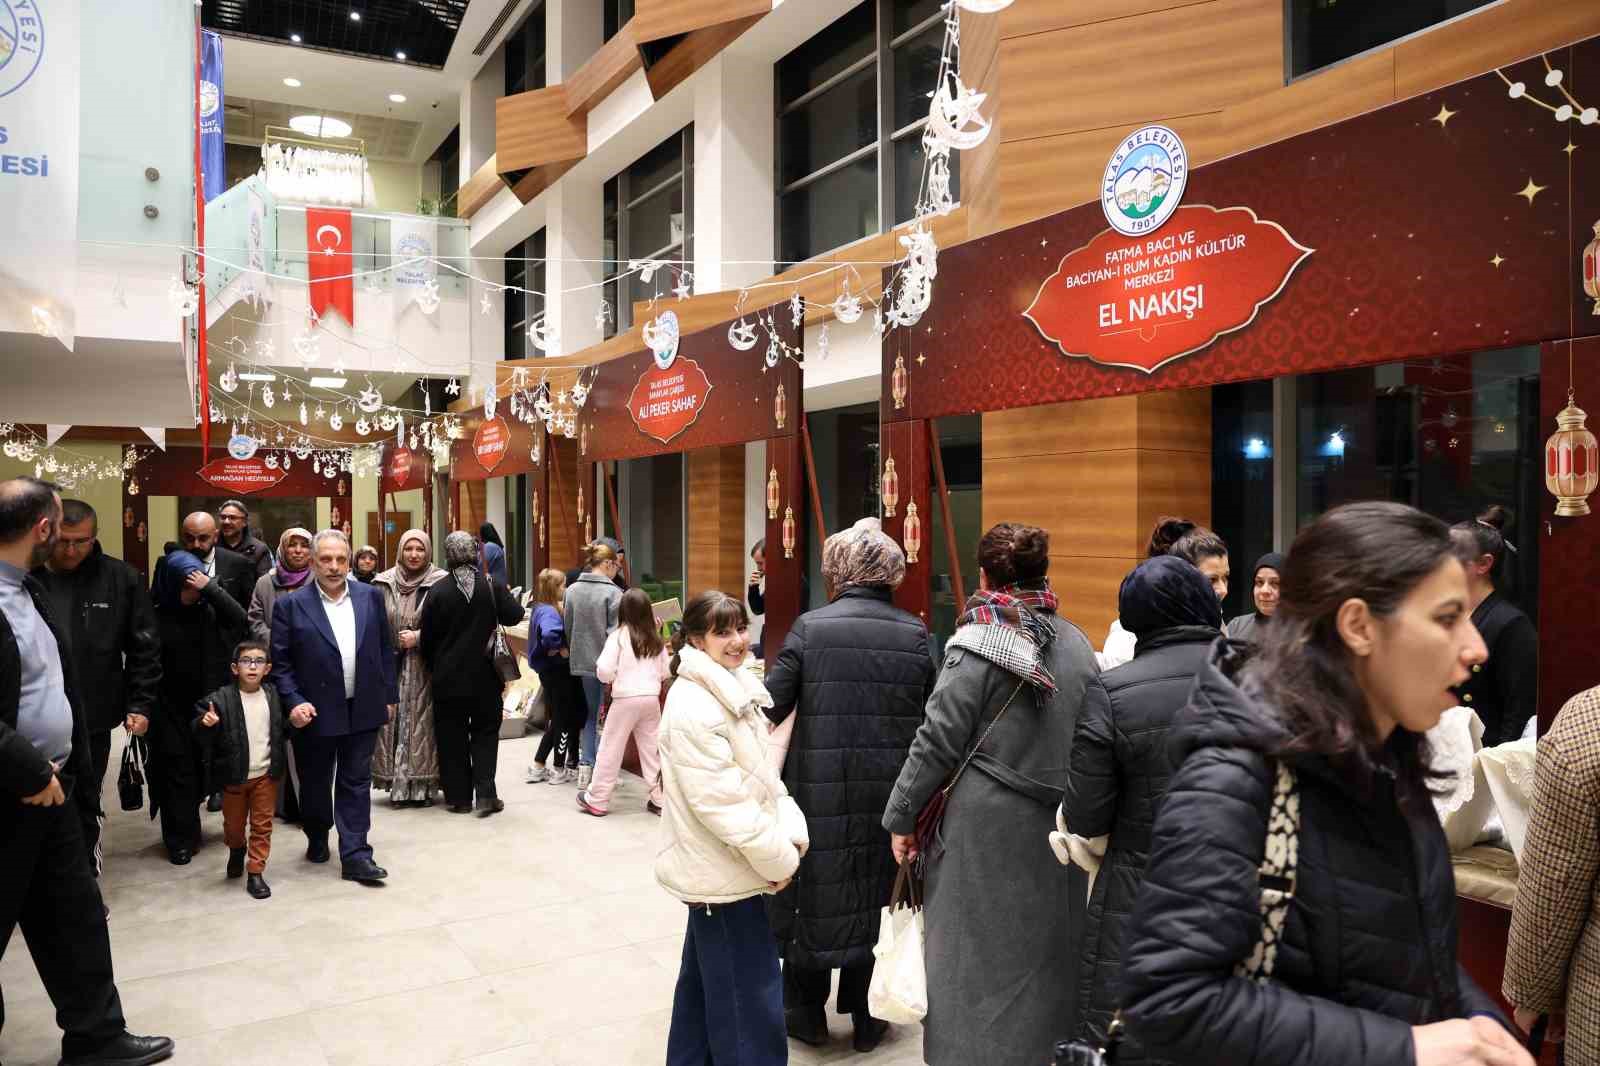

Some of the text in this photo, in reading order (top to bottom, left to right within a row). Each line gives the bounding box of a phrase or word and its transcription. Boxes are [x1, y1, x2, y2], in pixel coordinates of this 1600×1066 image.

[1131, 214, 1157, 231] 1907
[1105, 231, 1196, 264] FATMA BACI VE
[1123, 258, 1150, 274] RUM
[1153, 251, 1192, 268] KADIN
[1196, 233, 1246, 257] KÜLTÜR
[1124, 268, 1175, 290] MERKEZİ
[1099, 284, 1203, 327] EL NAKIŞI
[639, 395, 697, 419] ALİ PEKER SAHAF
